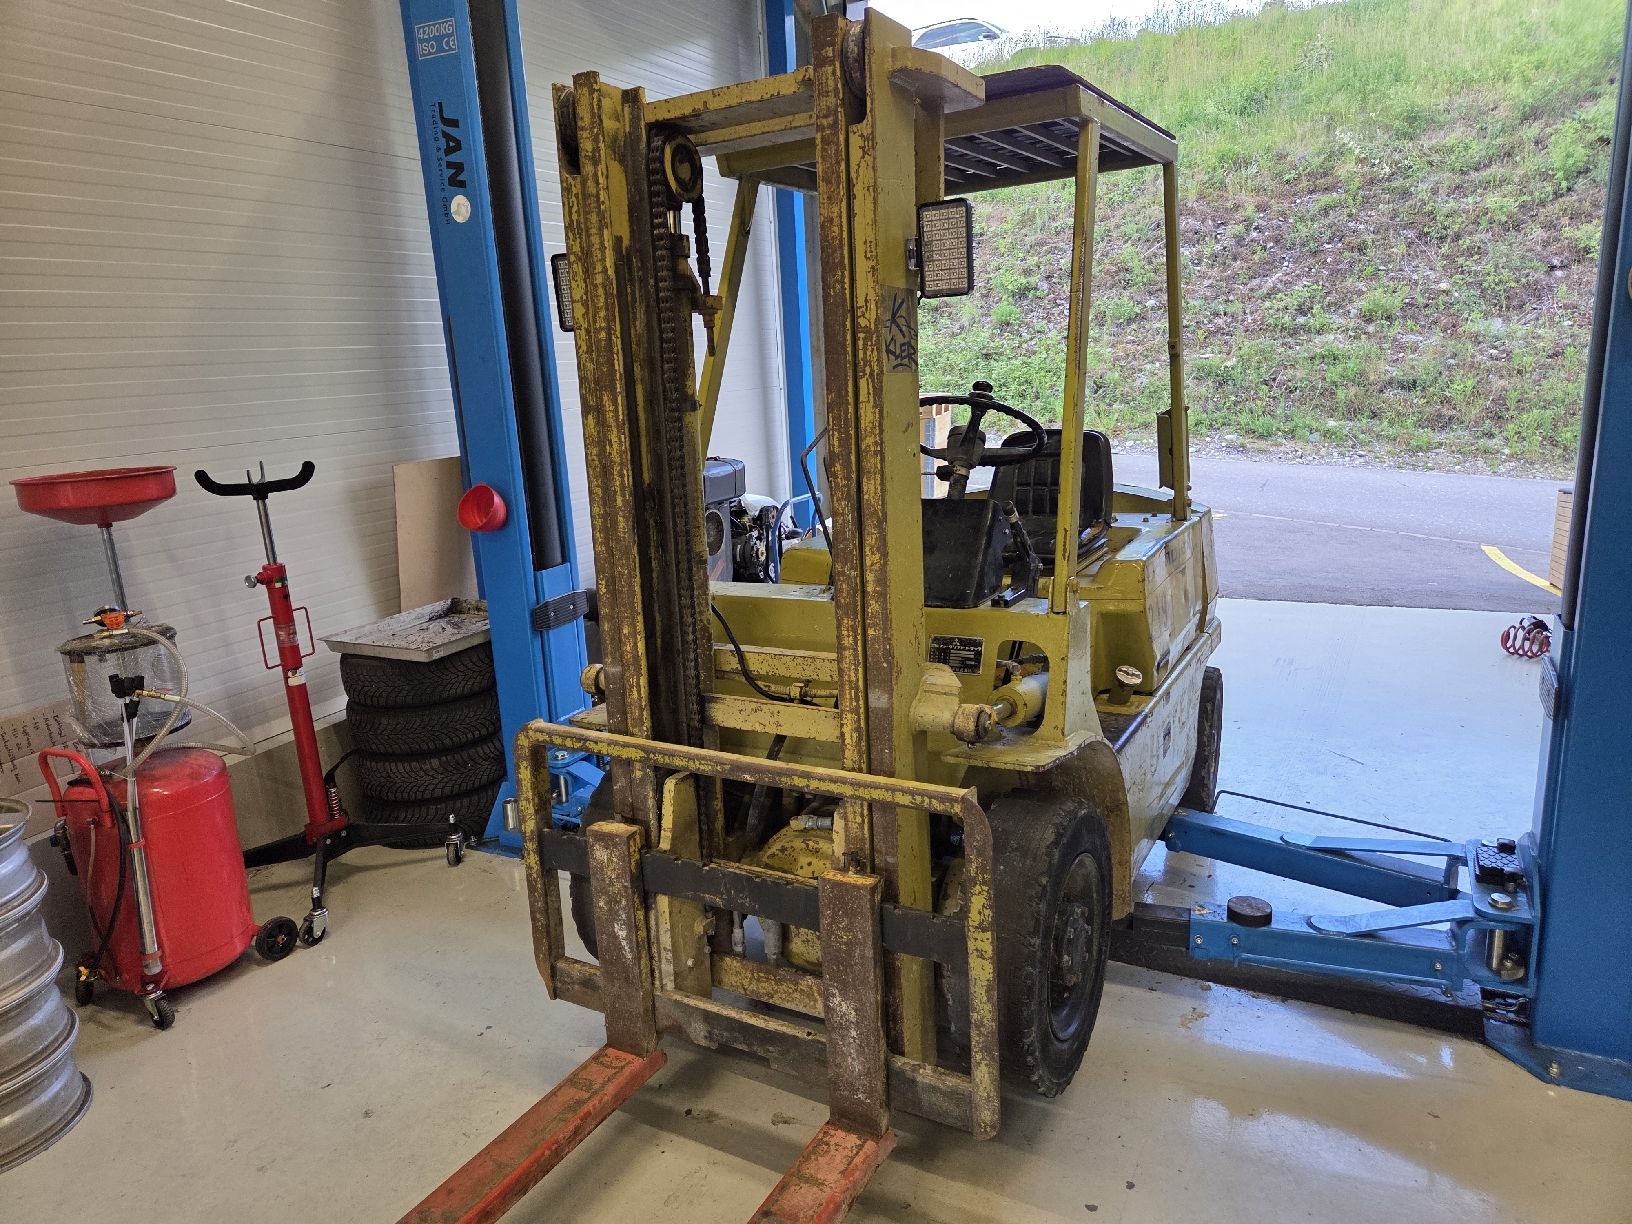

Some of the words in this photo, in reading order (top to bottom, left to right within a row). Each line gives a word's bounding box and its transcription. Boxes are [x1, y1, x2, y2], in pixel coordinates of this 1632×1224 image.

[418, 21, 453, 39] 4200KG
[418, 41, 437, 55] ISO
[429, 103, 439, 142] Trading
[437, 156, 446, 192] Service
[442, 197, 451, 225] GmbH
[438, 102, 467, 188] JAN
